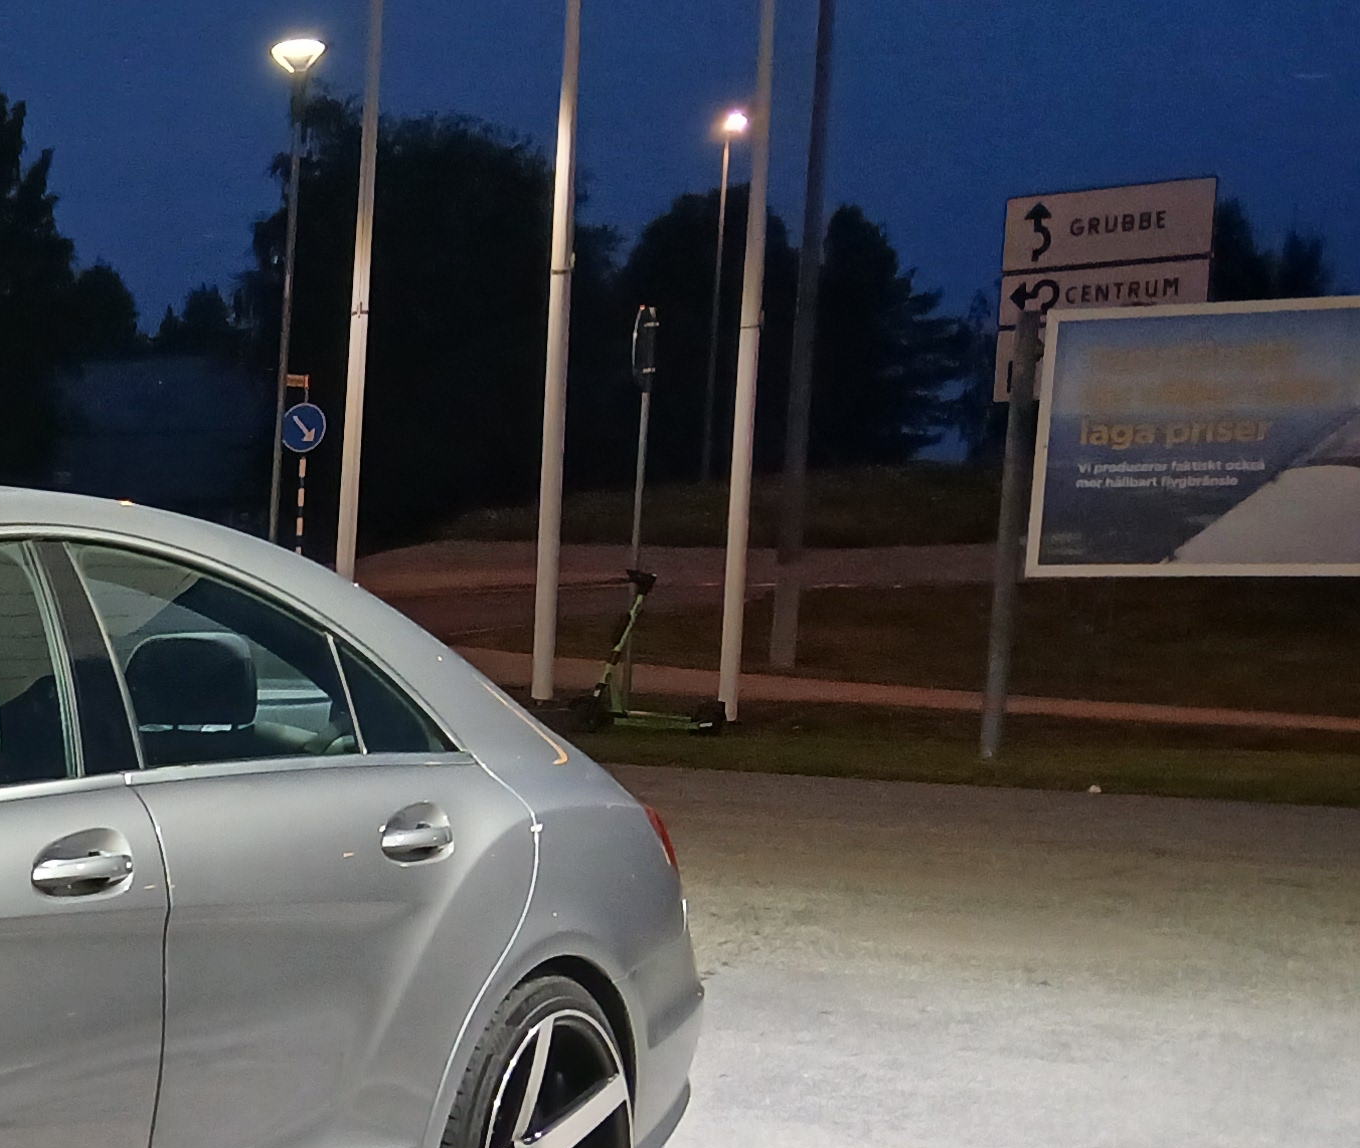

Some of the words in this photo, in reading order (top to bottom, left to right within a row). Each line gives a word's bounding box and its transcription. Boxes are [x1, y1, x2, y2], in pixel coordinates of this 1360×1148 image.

[1069, 210, 1167, 237] GRUBBE
[1065, 276, 1180, 305] CENTRUM
[1076, 478, 1103, 489] mer
